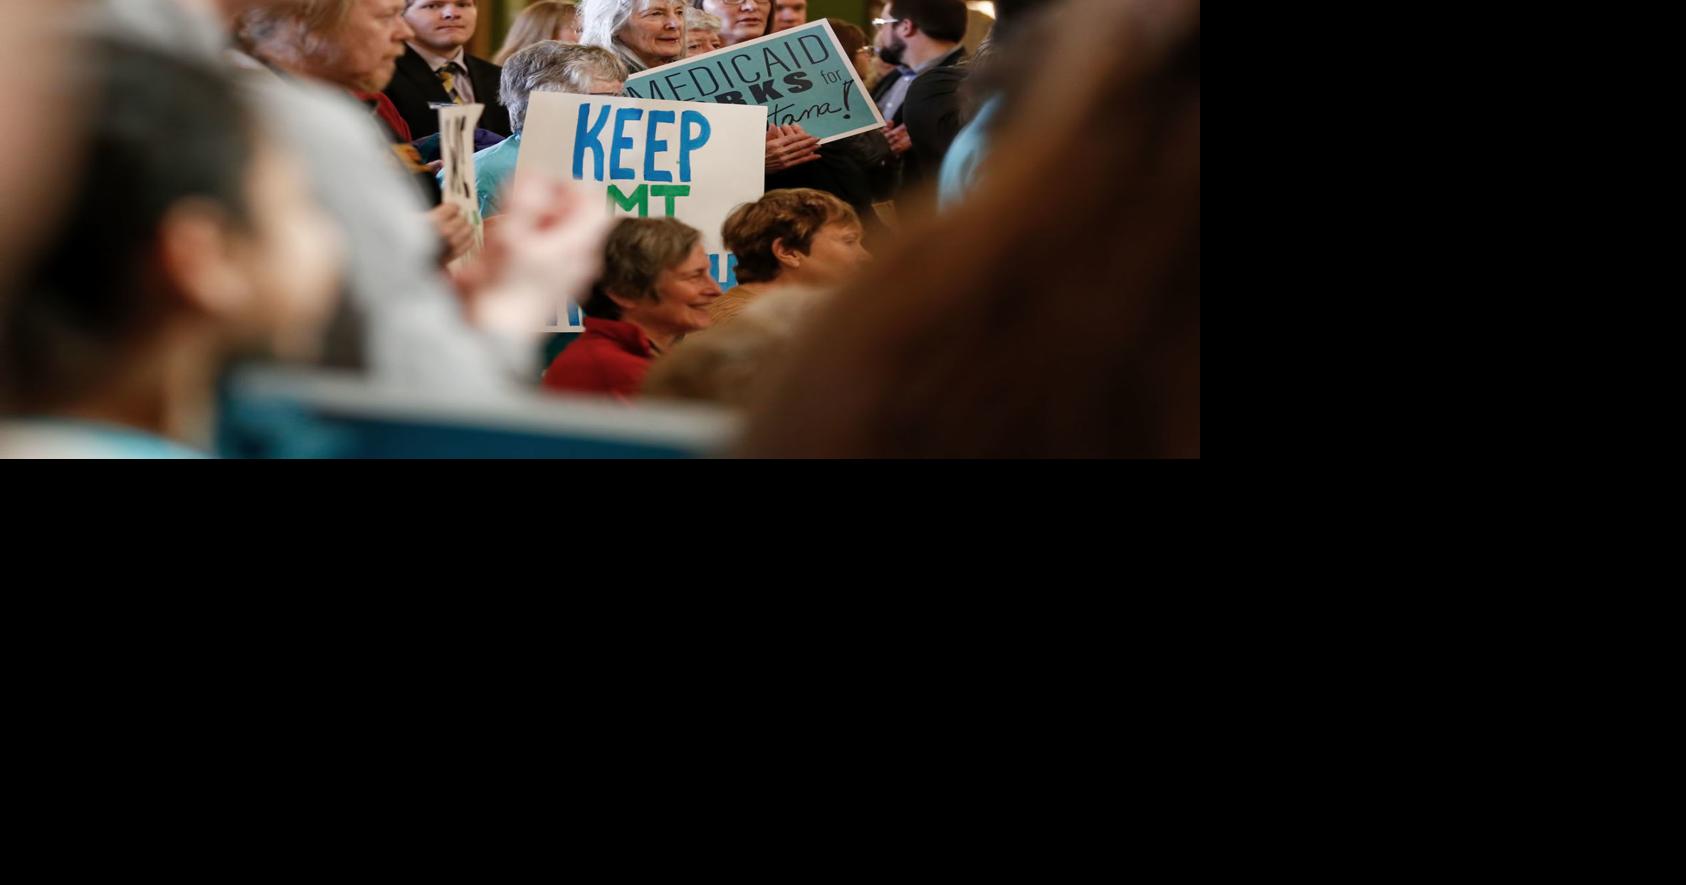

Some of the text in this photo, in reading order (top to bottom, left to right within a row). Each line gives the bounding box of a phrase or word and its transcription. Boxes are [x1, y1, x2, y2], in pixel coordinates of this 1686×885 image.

[626, 34, 830, 101] MEDICAID
[714, 69, 842, 105] RKS for
[767, 79, 854, 126] tana!
[572, 102, 711, 182] KEEP
[606, 184, 691, 217] MT
